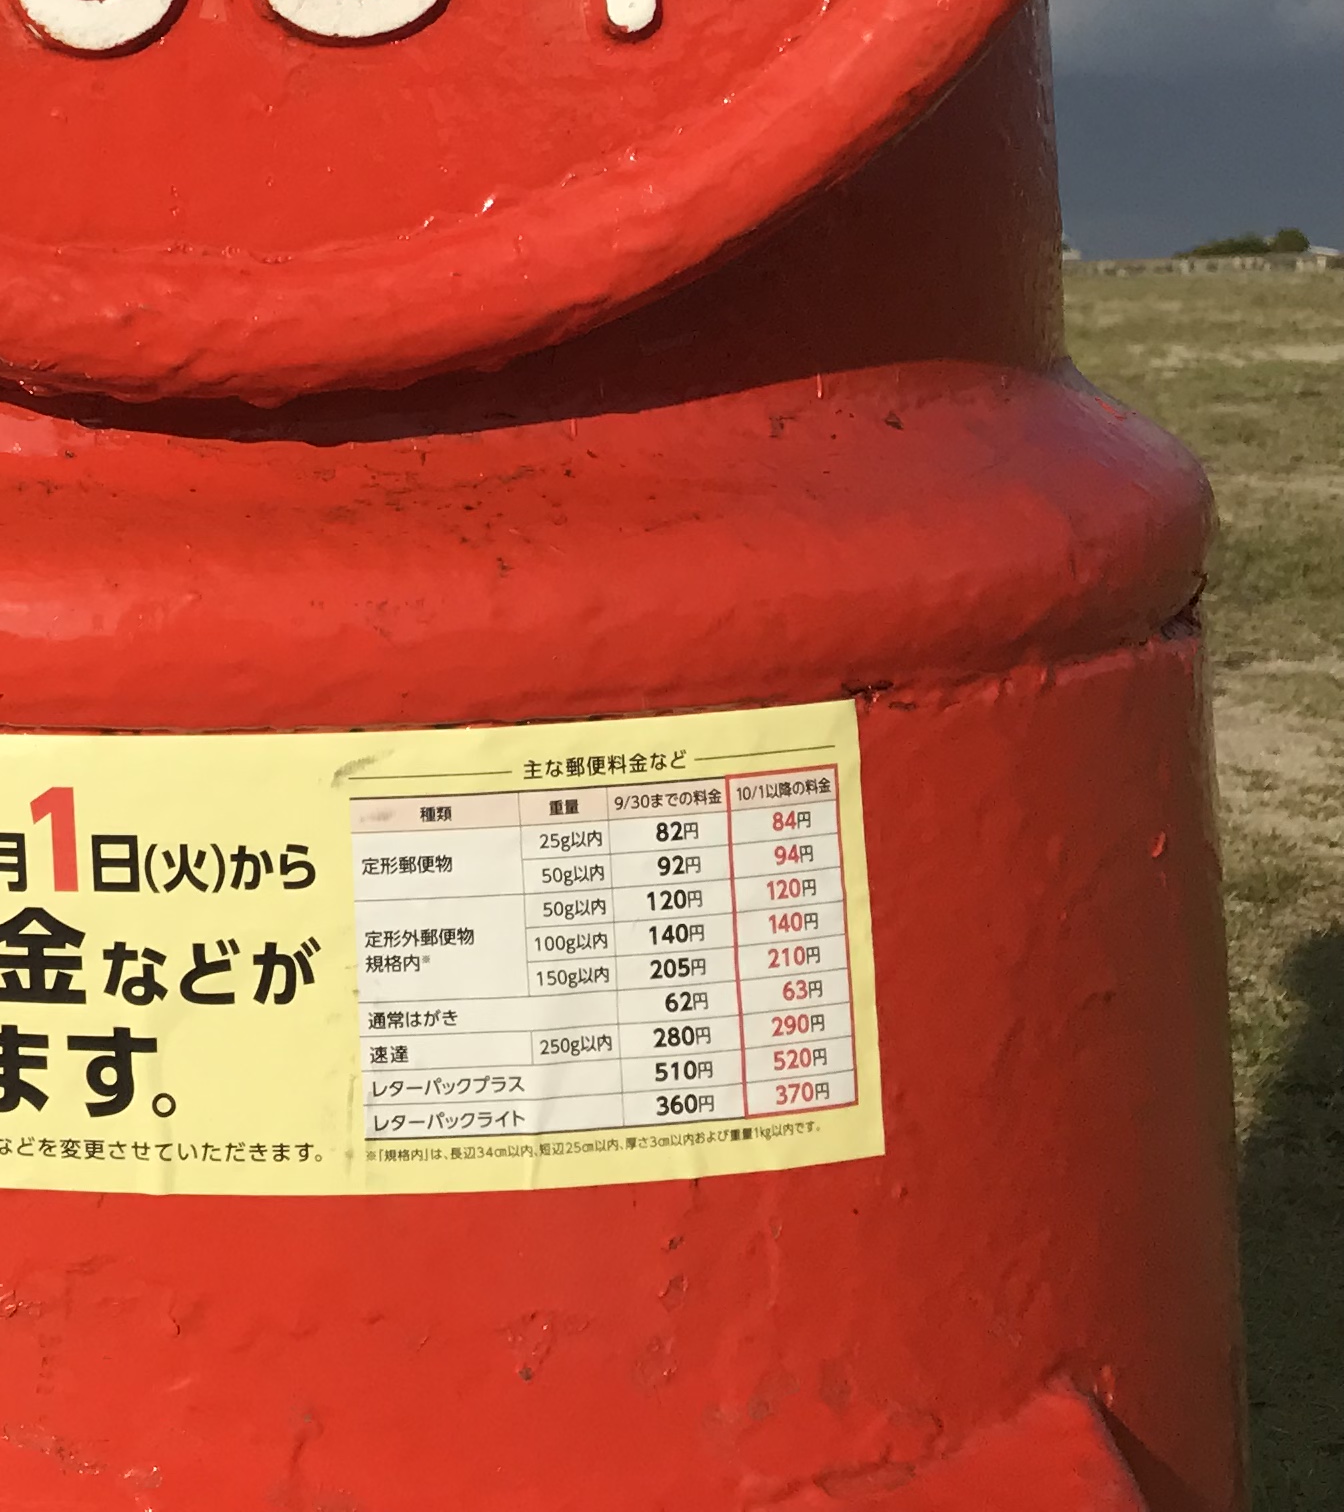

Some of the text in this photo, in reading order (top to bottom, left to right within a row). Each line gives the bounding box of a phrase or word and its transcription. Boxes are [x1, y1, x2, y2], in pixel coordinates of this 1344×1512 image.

[524, 750, 686, 779] 主な郵便料金など
[420, 777, 831, 822] 種類 重量 9/30までの料金 10/1以降の料金
[539, 811, 811, 852] 25g以内 82円 84円
[362, 854, 453, 876] 定形郵便物
[541, 844, 814, 887] 50g以内 92円 94円
[543, 878, 816, 920] 50g以内 120円 120円
[365, 927, 475, 948] 定形外郵便物
[534, 911, 819, 954] 100g以内 140円 140円
[536, 945, 821, 988] 150g以内 205円 210円
[368, 979, 823, 1030] 通常はがき 62円 63円
[370, 1013, 825, 1064] 速達 250g以内 280円 290円
[372, 1047, 827, 1097] レターパックプラス 510円 520円
[374, 1081, 830, 1131] レターパックライト 360円 370円
